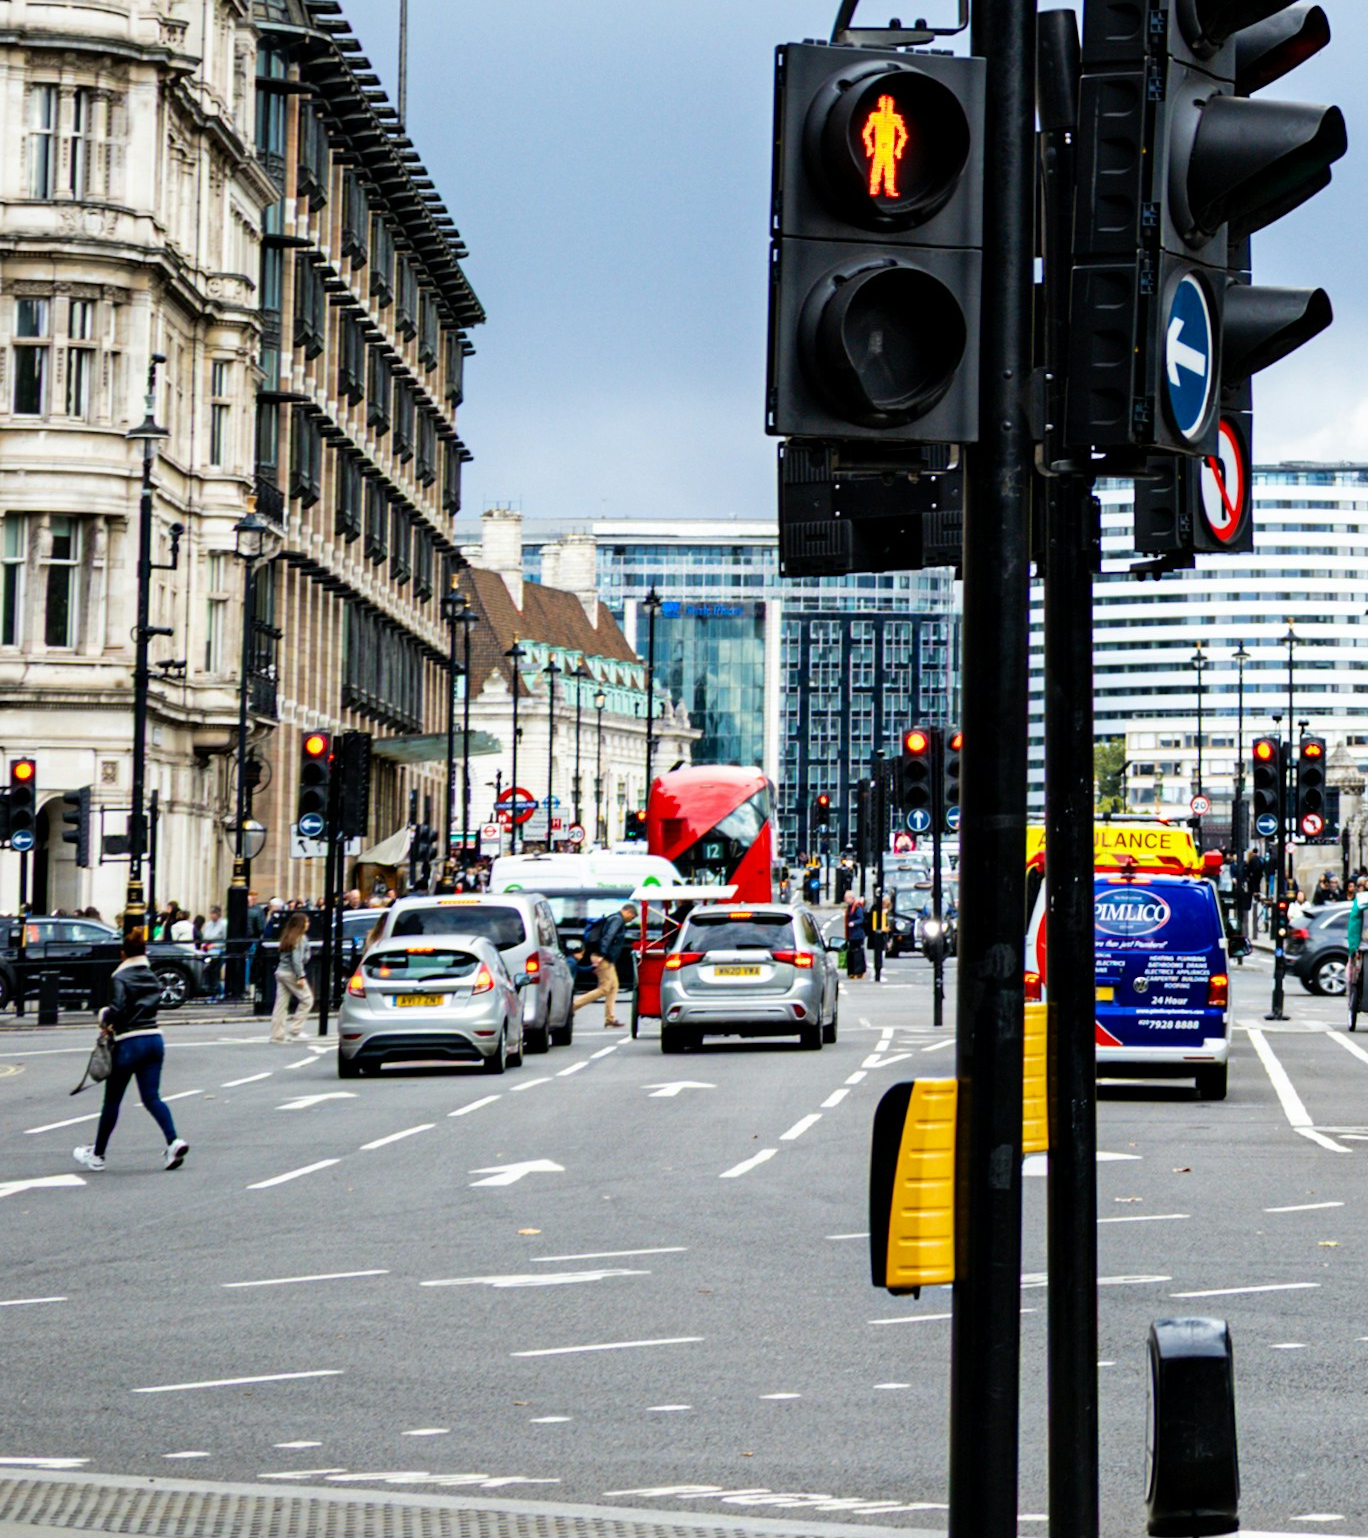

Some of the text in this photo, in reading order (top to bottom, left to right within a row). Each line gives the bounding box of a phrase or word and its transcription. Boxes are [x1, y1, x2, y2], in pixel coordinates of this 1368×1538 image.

[570, 830, 582, 839] 20
[706, 843, 720, 859] 12
[1150, 996, 1188, 1005] 24 Hour
[1174, 1020, 1200, 1030] 8888
